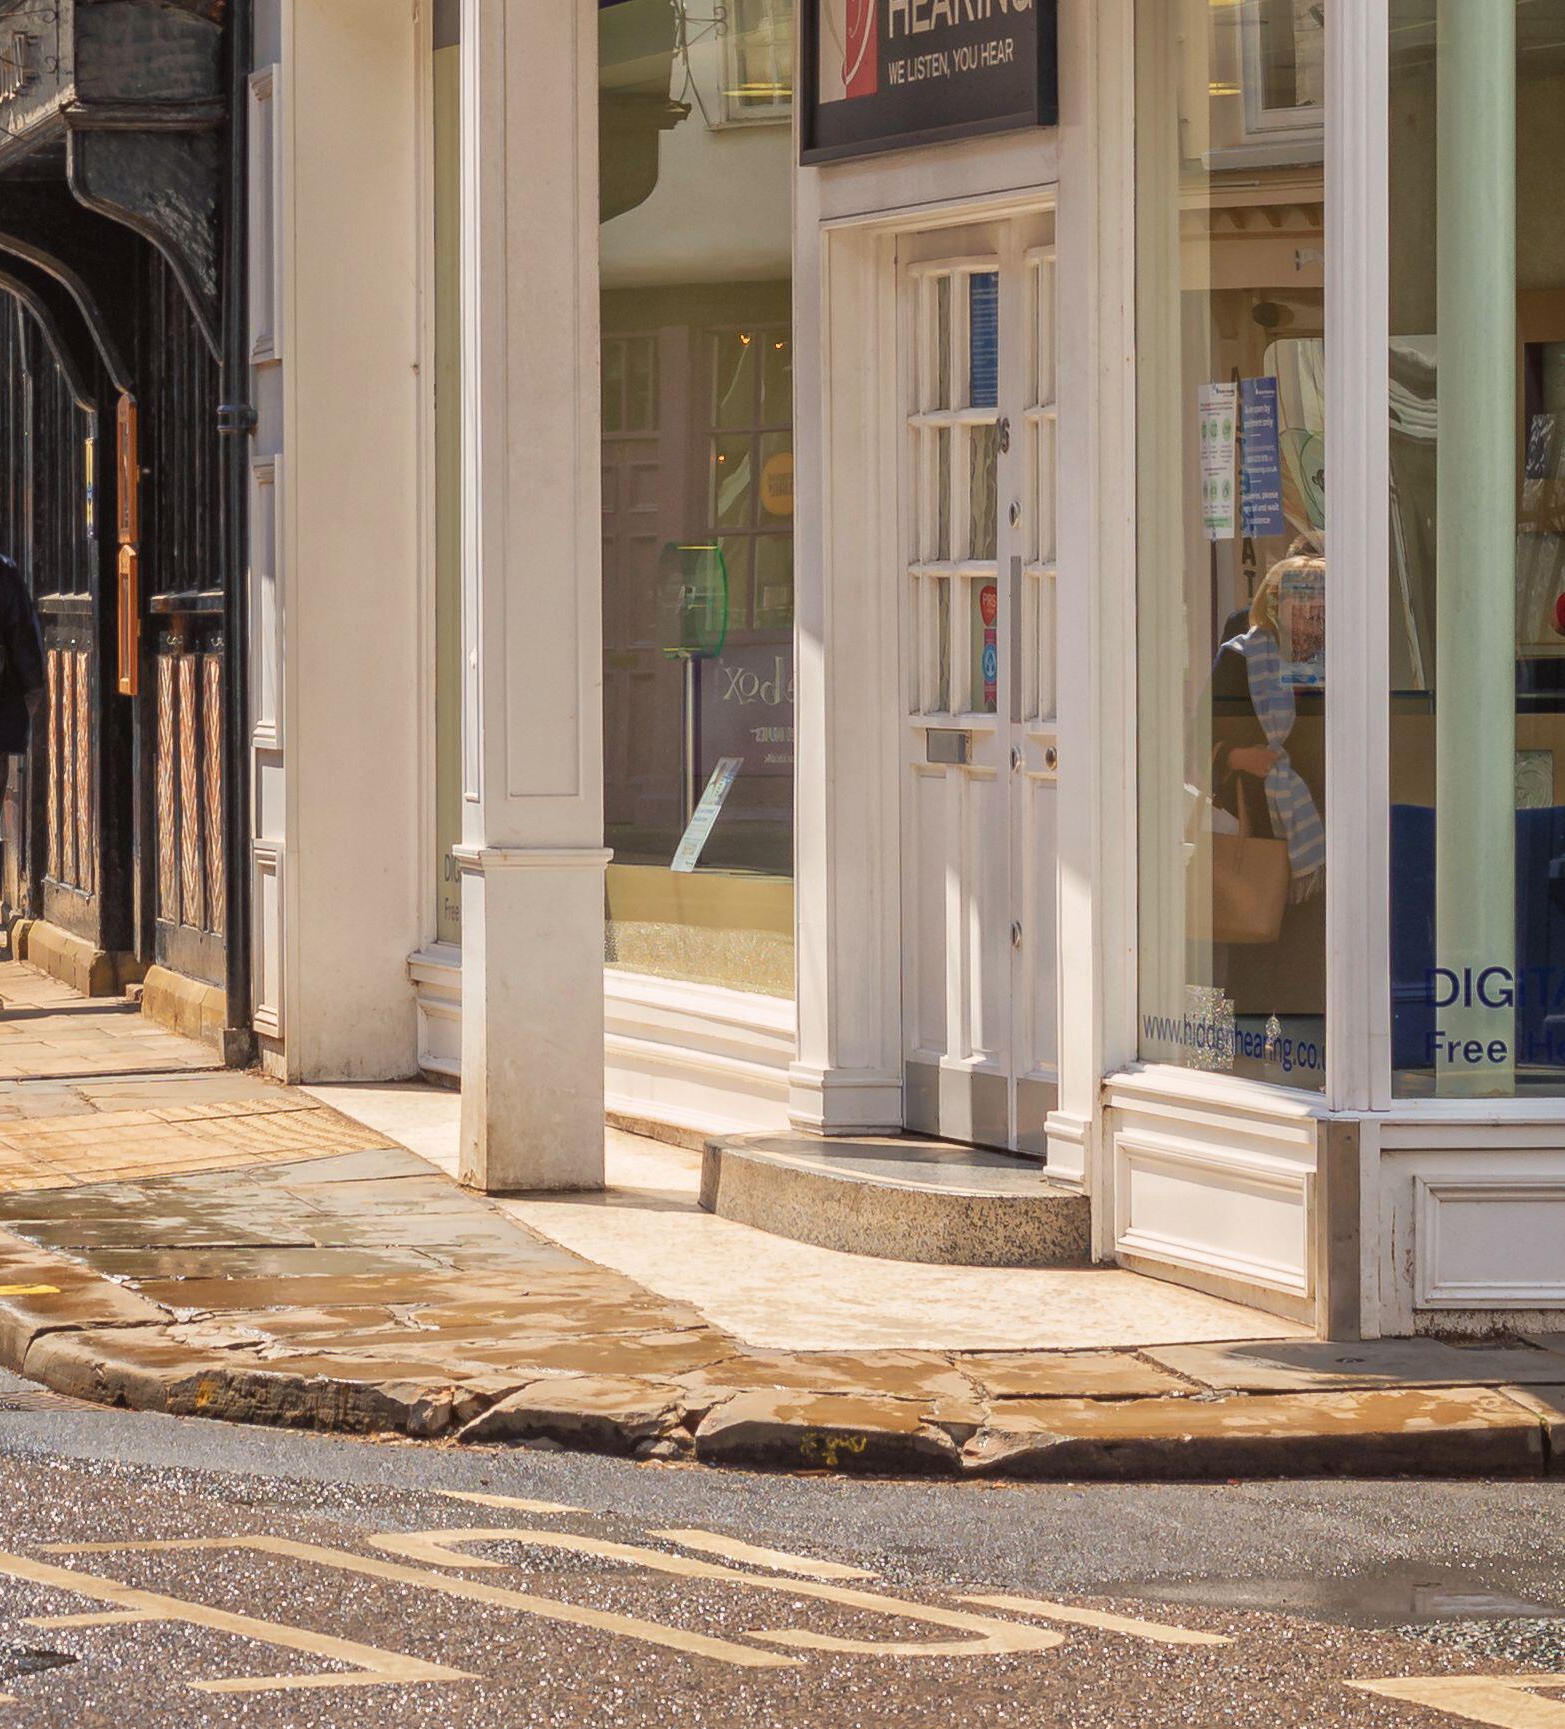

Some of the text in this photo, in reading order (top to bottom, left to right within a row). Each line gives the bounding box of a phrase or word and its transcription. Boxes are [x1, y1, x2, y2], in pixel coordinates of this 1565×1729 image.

[888, 38, 1015, 85] WE LISTEN, YOU HEAR
[1425, 1030, 1508, 1065] Free
